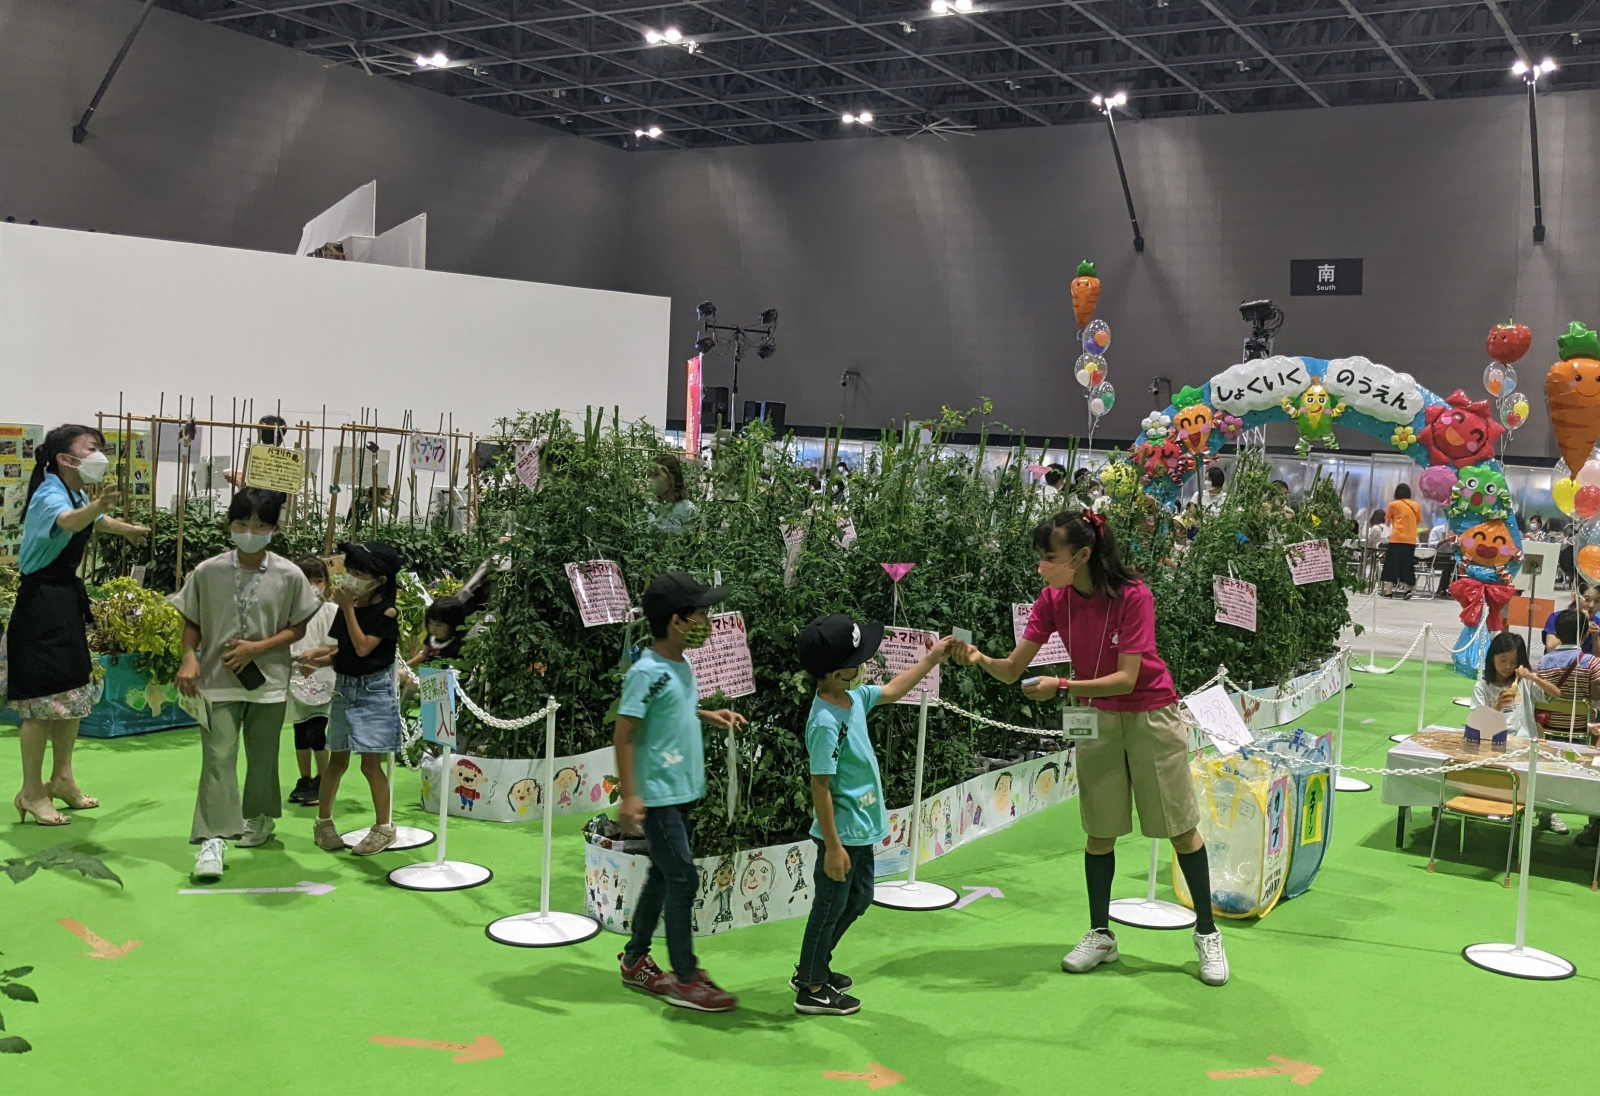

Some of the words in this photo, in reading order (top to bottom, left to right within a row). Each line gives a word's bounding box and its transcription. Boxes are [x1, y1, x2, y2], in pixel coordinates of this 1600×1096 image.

[1318, 264, 1335, 283] 南
[1217, 367, 1303, 402] しょくいく
[1336, 368, 1408, 411] のうえん
